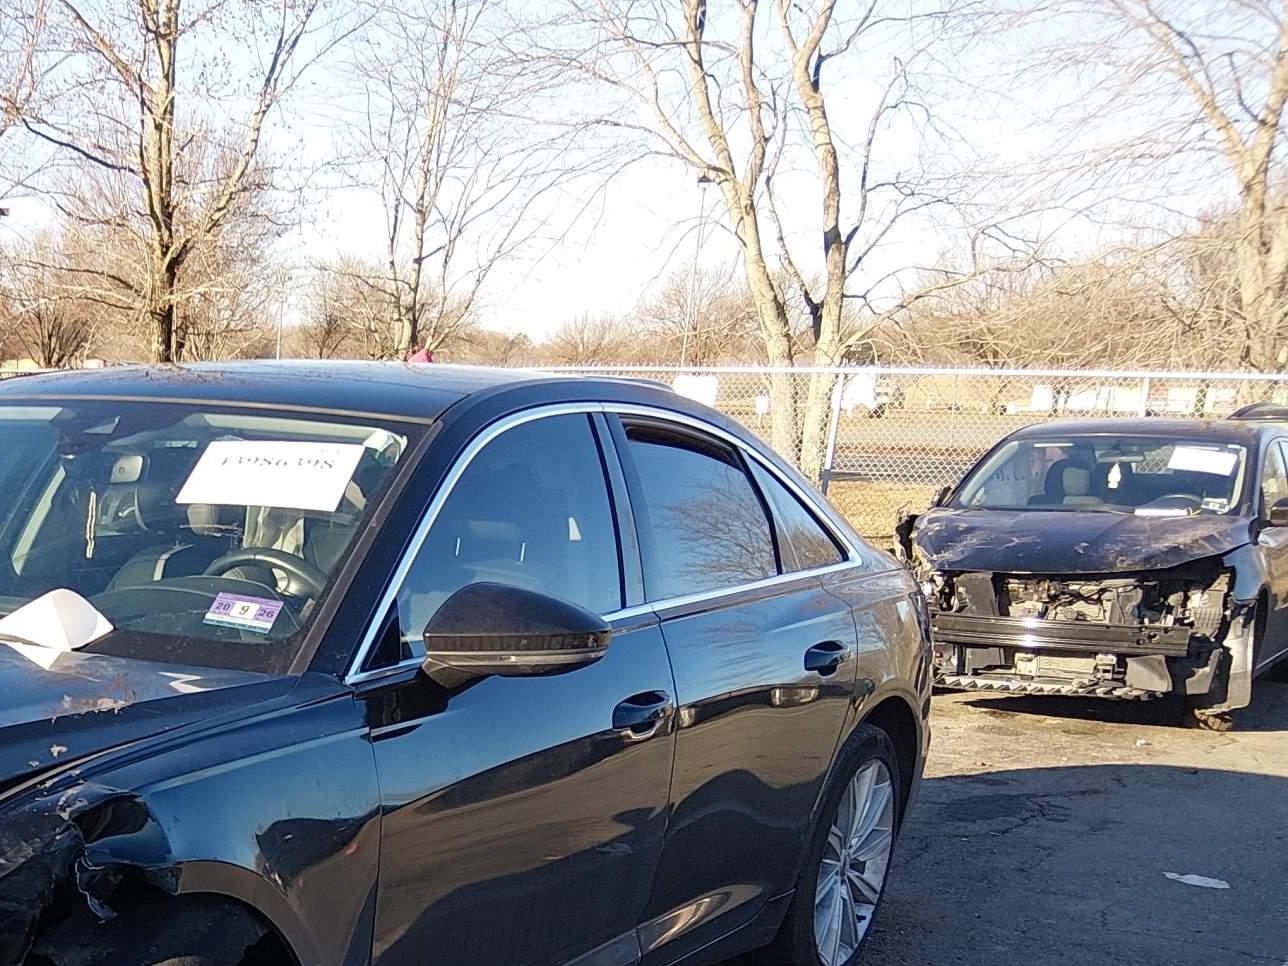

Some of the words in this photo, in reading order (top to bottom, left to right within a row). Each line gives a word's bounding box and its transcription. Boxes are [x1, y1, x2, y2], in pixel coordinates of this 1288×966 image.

[215, 602, 231, 611] 20
[239, 605, 250, 615] 9
[257, 609, 274, 618] 26
